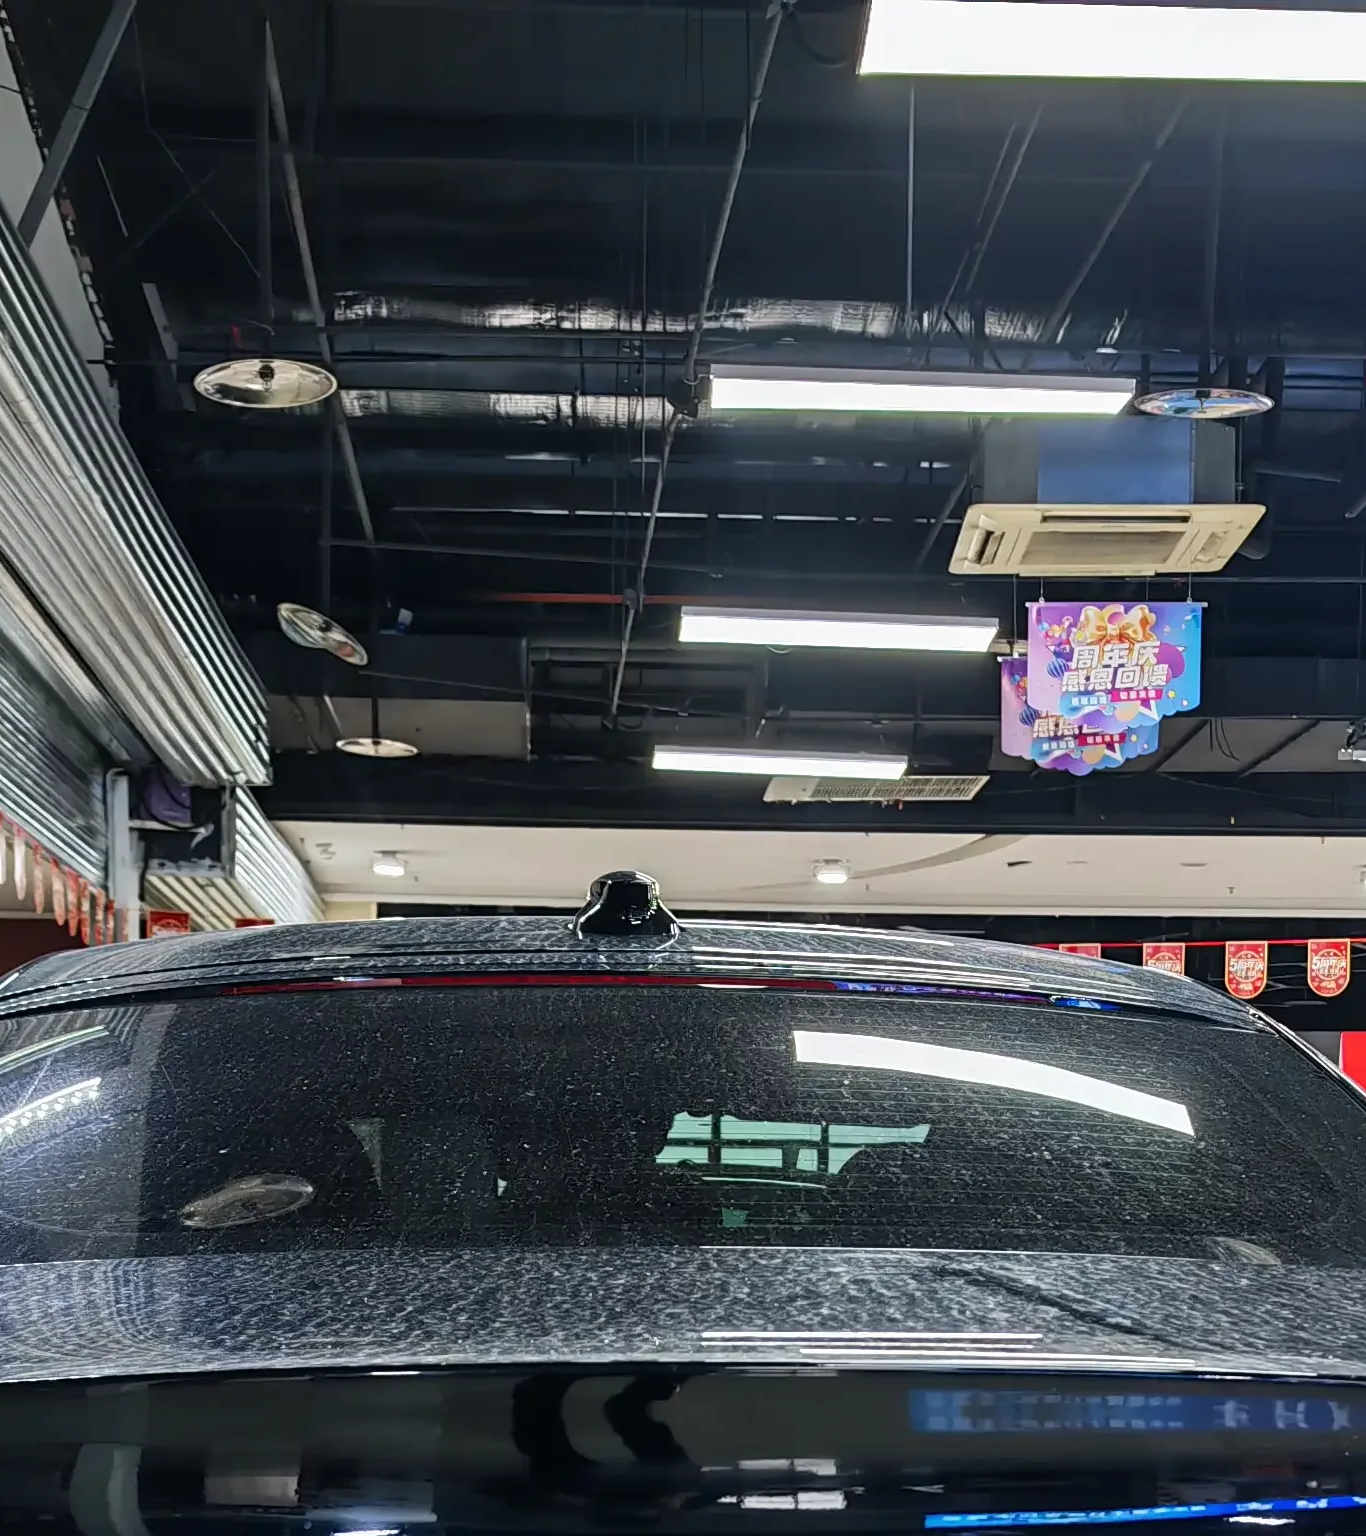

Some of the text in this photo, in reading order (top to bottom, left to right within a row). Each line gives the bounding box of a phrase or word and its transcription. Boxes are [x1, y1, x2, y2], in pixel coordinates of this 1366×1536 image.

[1071, 641, 1160, 669] 周年庆
[1062, 664, 1169, 691] 感恩回馈
